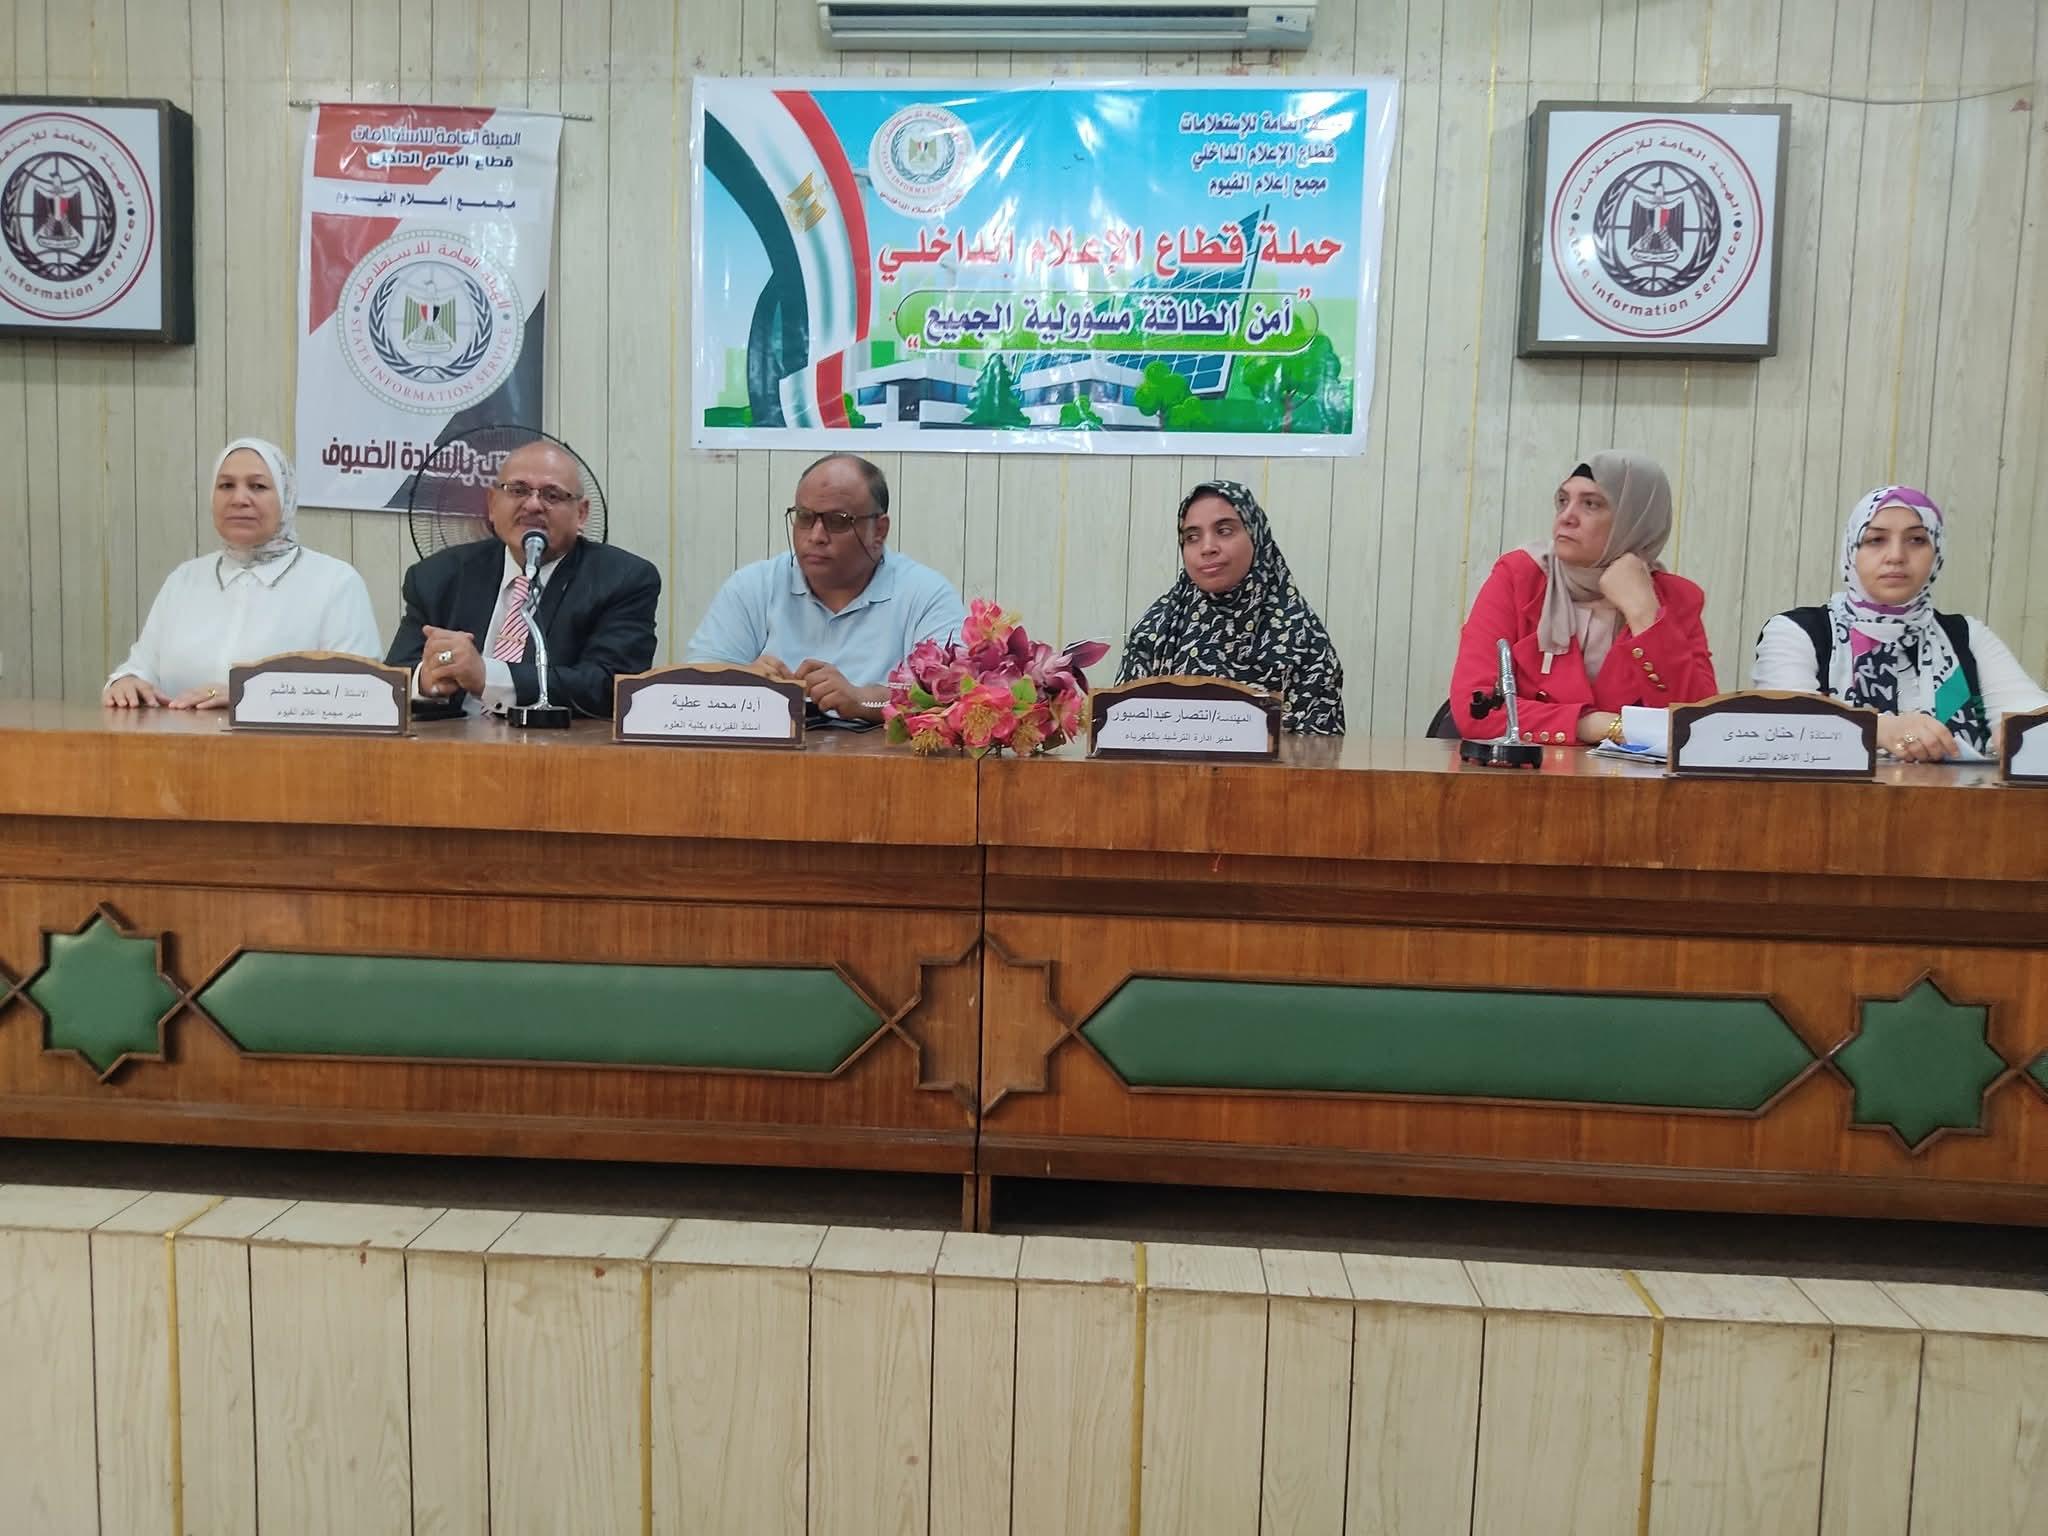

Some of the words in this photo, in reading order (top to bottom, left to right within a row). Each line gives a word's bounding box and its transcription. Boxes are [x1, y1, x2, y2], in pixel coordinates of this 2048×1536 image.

[53, 128, 97, 153] العامة
[436, 127, 479, 147] العامة
[483, 129, 521, 149] الهيئة
[1659, 135, 1707, 162] العامة
[476, 153, 514, 171] قطاع
[1193, 143, 1244, 169] الداخلي
[1209, 173, 1250, 195] الفيوم
[1255, 174, 1289, 196] إعلام
[1294, 176, 1328, 197] مجمع
[400, 191, 452, 211] إعلام
[457, 196, 517, 213] مجمع
[437, 243, 481, 271] العامة
[878, 226, 1014, 282] الداخلي
[1029, 228, 1143, 275] الإعلام
[1156, 223, 1244, 277] قطاع
[1258, 223, 1343, 266] حملة
[4, 266, 94, 301] information
[99, 219, 136, 285] service
[1592, 281, 1689, 317] information
[1694, 230, 1743, 300] service
[926, 301, 1012, 343] الجميع
[1143, 295, 1237, 333] الطاقة
[1247, 298, 1292, 341] أمن
[351, 317, 372, 363] STATE
[368, 365, 476, 402] INFORMATION
[475, 325, 513, 386] SERVICE
[321, 436, 397, 475] الضيوف
[301, 685, 331, 697] محمد
[671, 693, 702, 711] عطية
[707, 698, 737, 711] محمد
[1765, 725, 1795, 743] حنان
